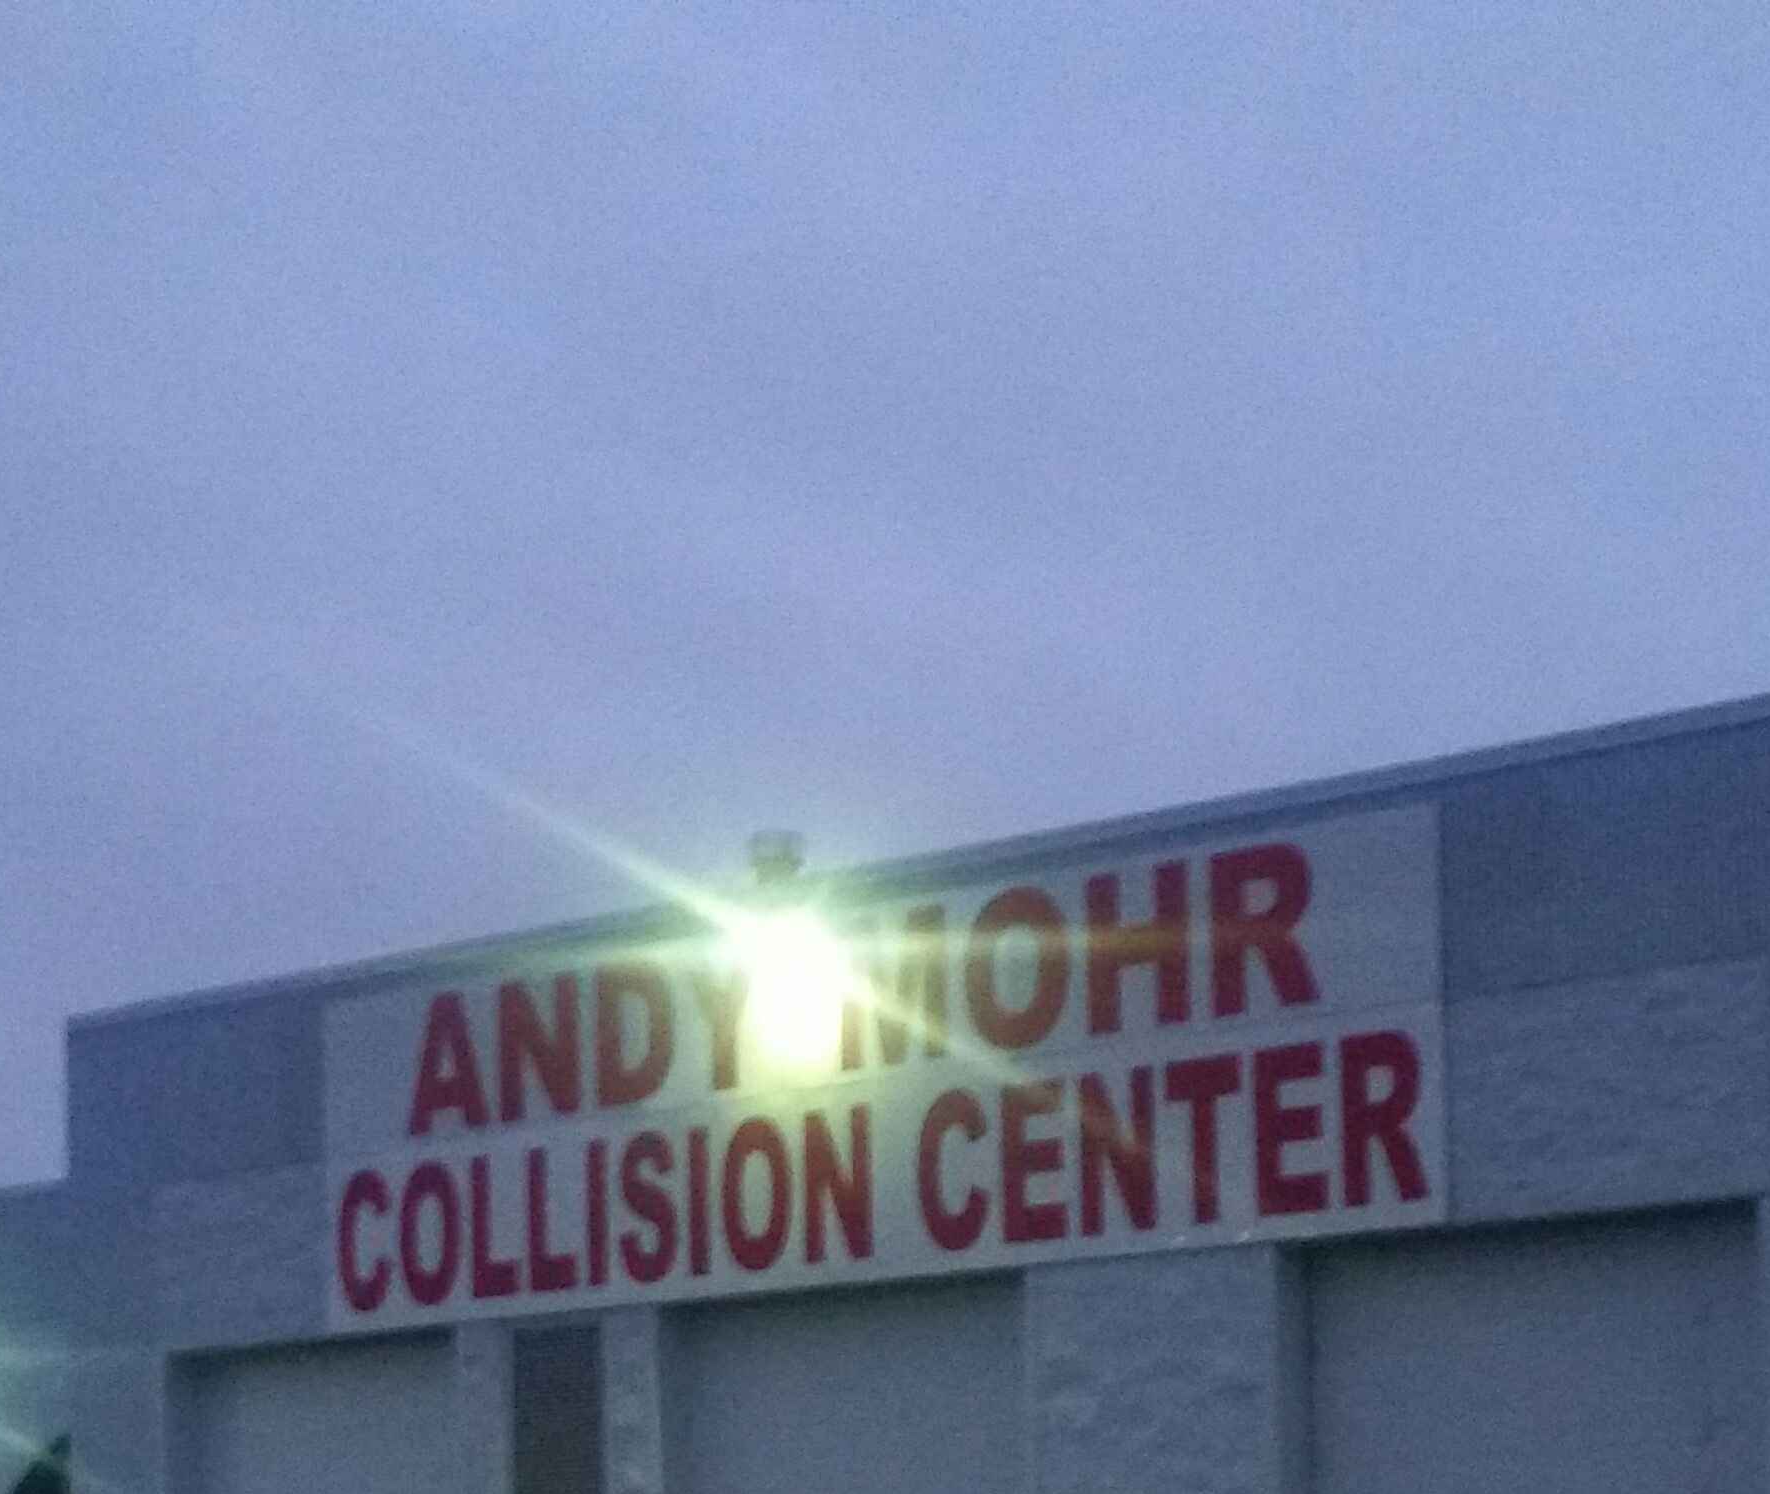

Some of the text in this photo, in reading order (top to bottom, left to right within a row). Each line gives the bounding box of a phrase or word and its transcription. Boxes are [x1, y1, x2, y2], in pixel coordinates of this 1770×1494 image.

[405, 840, 1323, 1138] ANDY MOHR
[335, 1028, 1431, 1314] COLLISION CENTER
